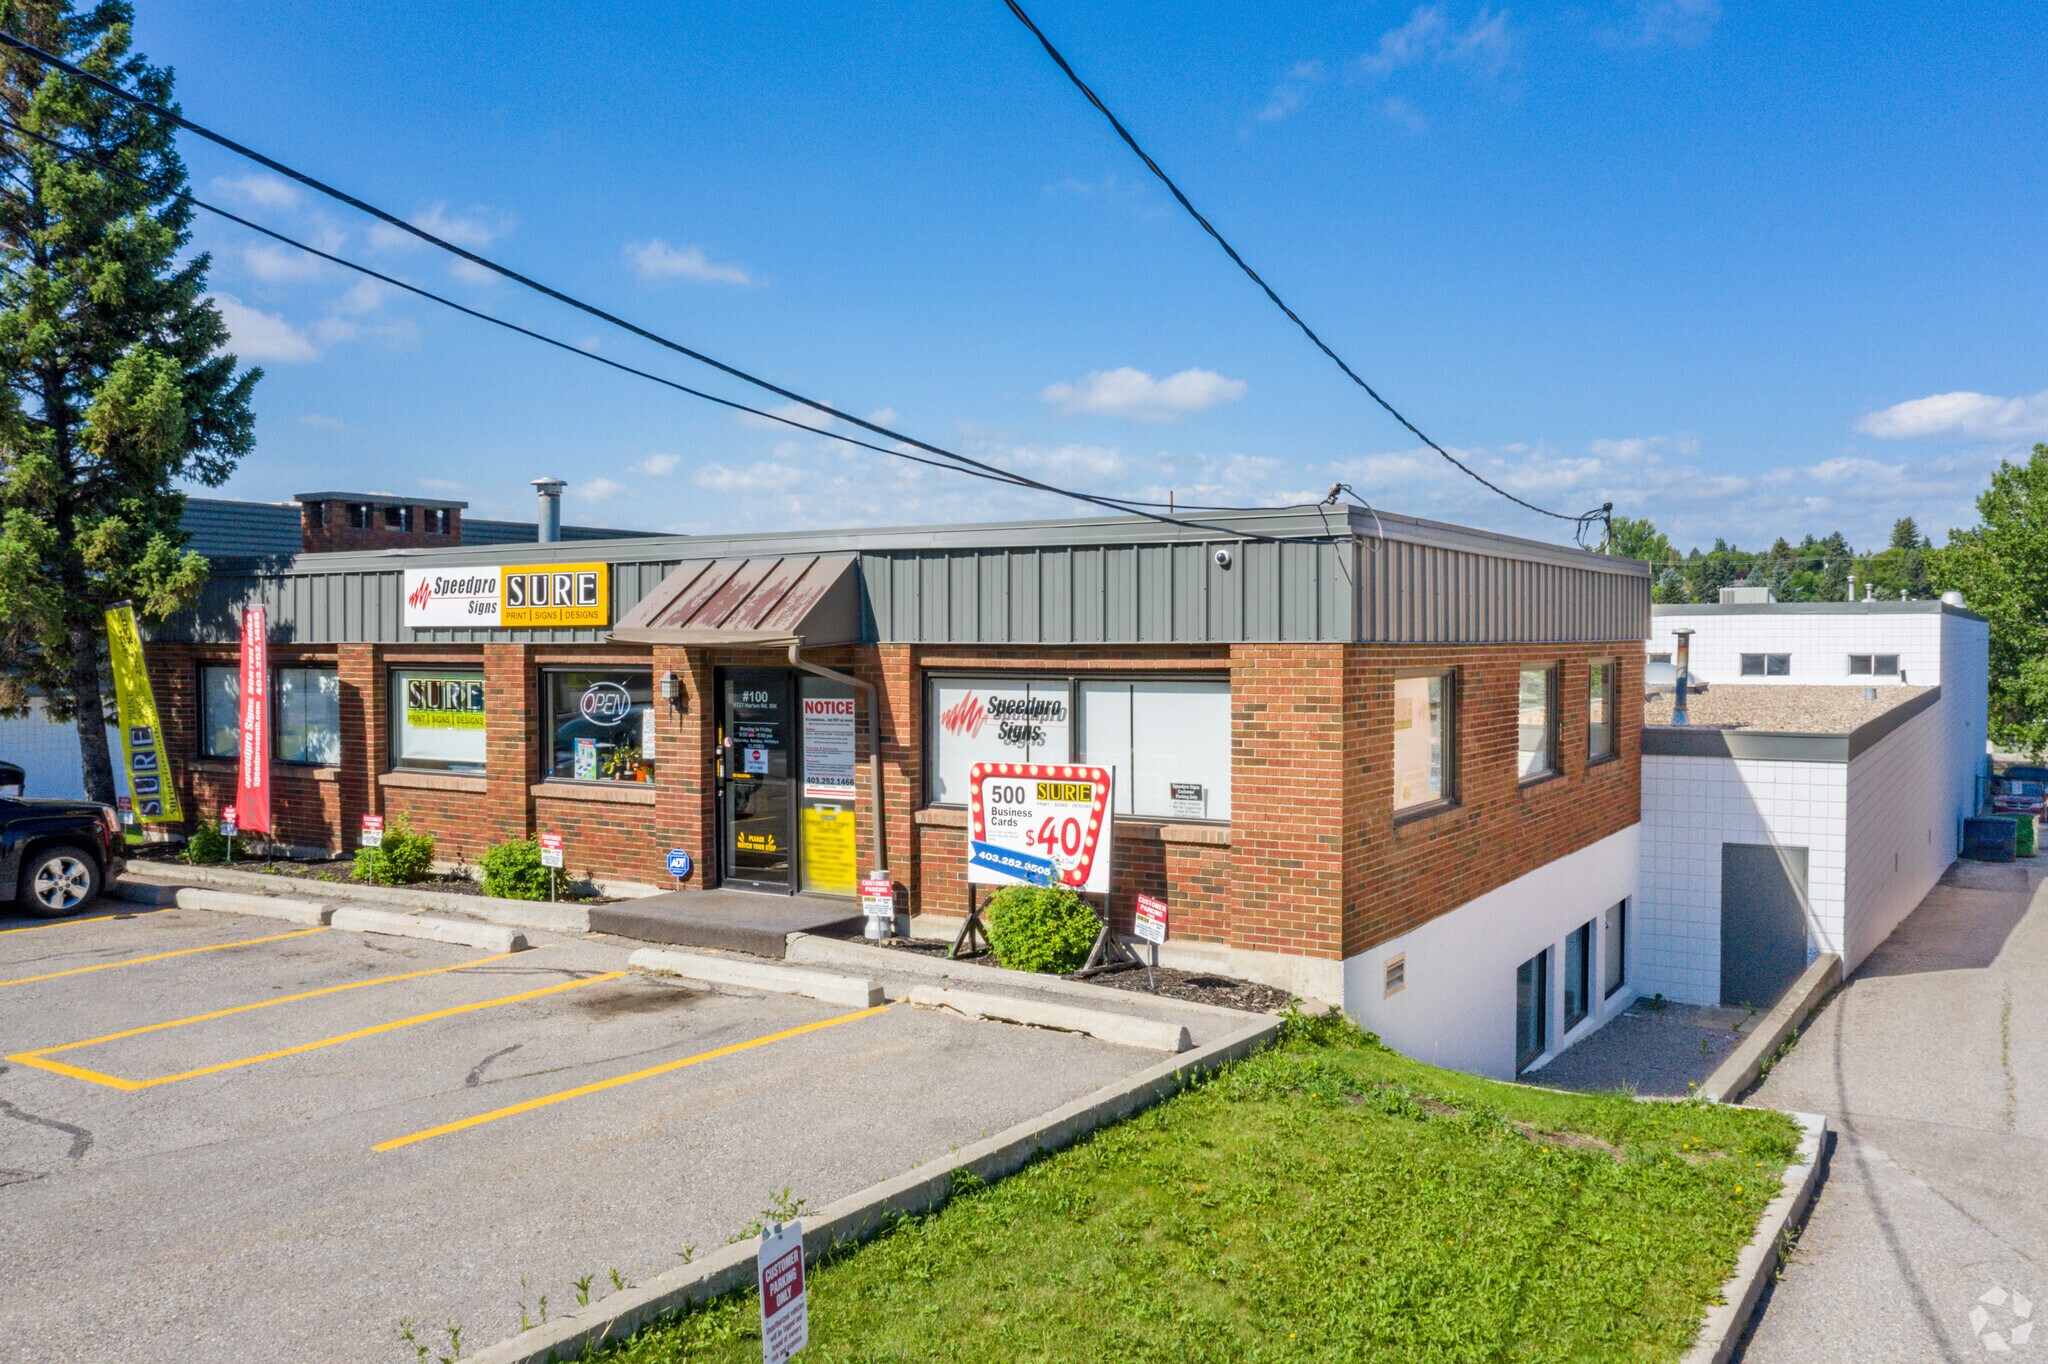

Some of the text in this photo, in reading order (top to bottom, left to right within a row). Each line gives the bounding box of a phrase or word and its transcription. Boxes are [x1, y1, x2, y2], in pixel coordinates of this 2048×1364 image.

[434, 576, 496, 596] Speedpro
[507, 573, 598, 607] SURE
[468, 601, 498, 615] Signs
[506, 610, 599, 620] PRINT SIGNS DESIGNS
[409, 681, 483, 711] SURE
[583, 693, 627, 716] OPEN
[742, 691, 768, 703] #100
[805, 701, 853, 715] NOTICE
[987, 696, 1061, 718] Speedpro
[432, 716, 450, 724] SIGNS
[456, 716, 484, 725] DESIGNS
[998, 721, 1041, 742] Signs
[131, 726, 162, 815] SURE
[806, 777, 854, 786] 403.252.1466
[991, 783, 1091, 804] 500 SURE
[991, 807, 1033, 818] Business
[991, 817, 1018, 827] Cards
[749, 835, 765, 843] PLEASE
[1026, 817, 1081, 856] $40
[671, 857, 686, 868] ADT
[1138, 896, 1167, 912] CUSTOMER
[1140, 904, 1163, 918] PARKING
[765, 1250, 799, 1283] CUSTOMER
[769, 1267, 797, 1297] PARKING
[776, 1286, 792, 1307] ONLY
